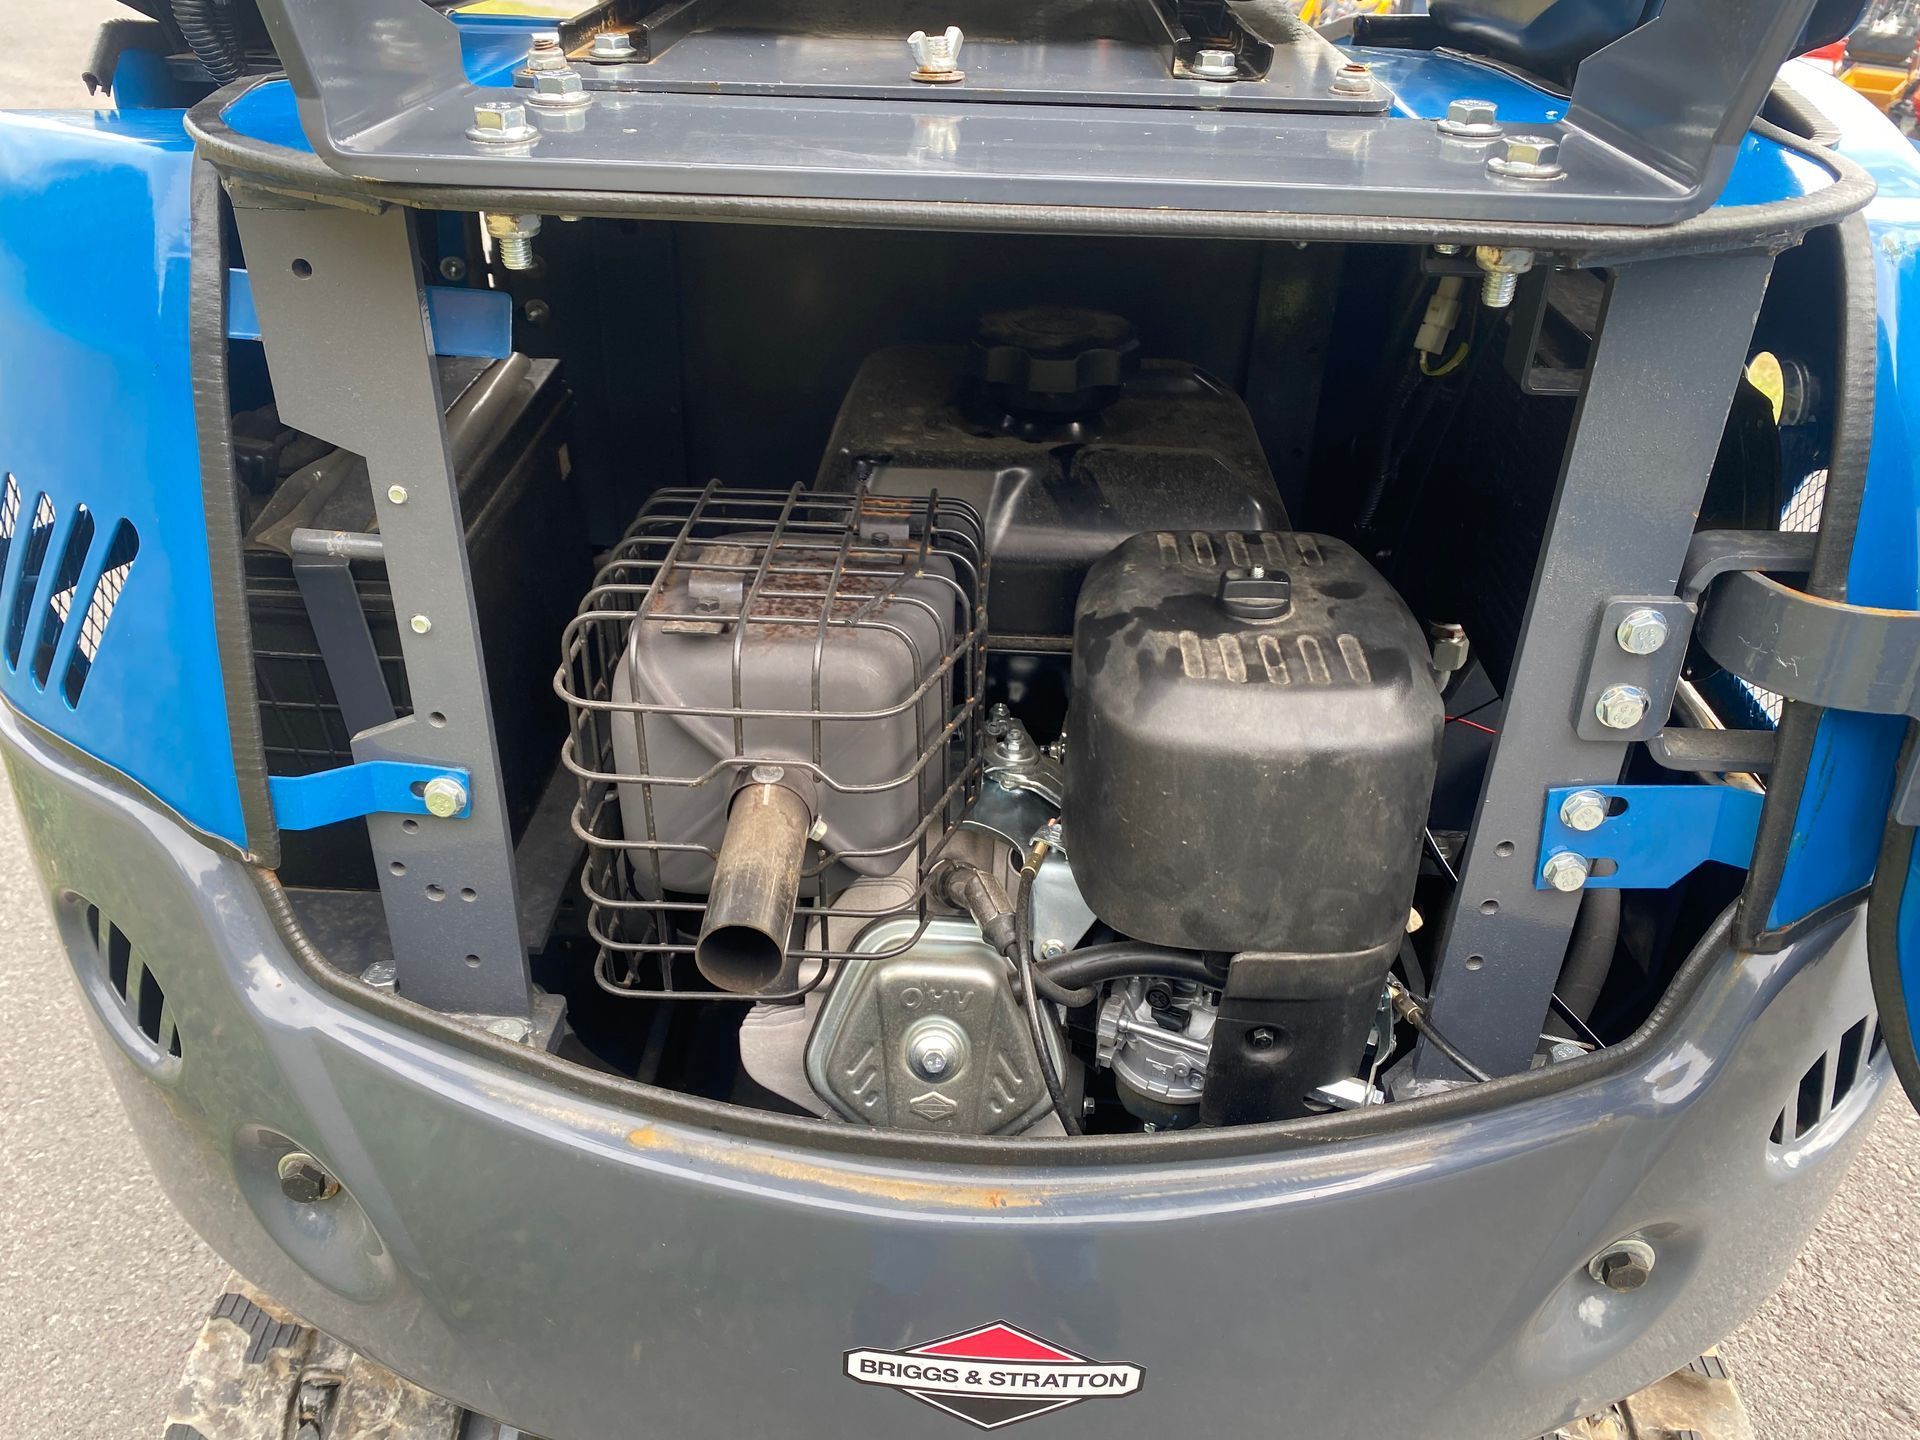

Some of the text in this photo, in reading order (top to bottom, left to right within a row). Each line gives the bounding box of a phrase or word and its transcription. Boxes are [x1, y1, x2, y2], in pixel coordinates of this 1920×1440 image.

[860, 1359, 1128, 1388] BRIGGS & STRATTON
